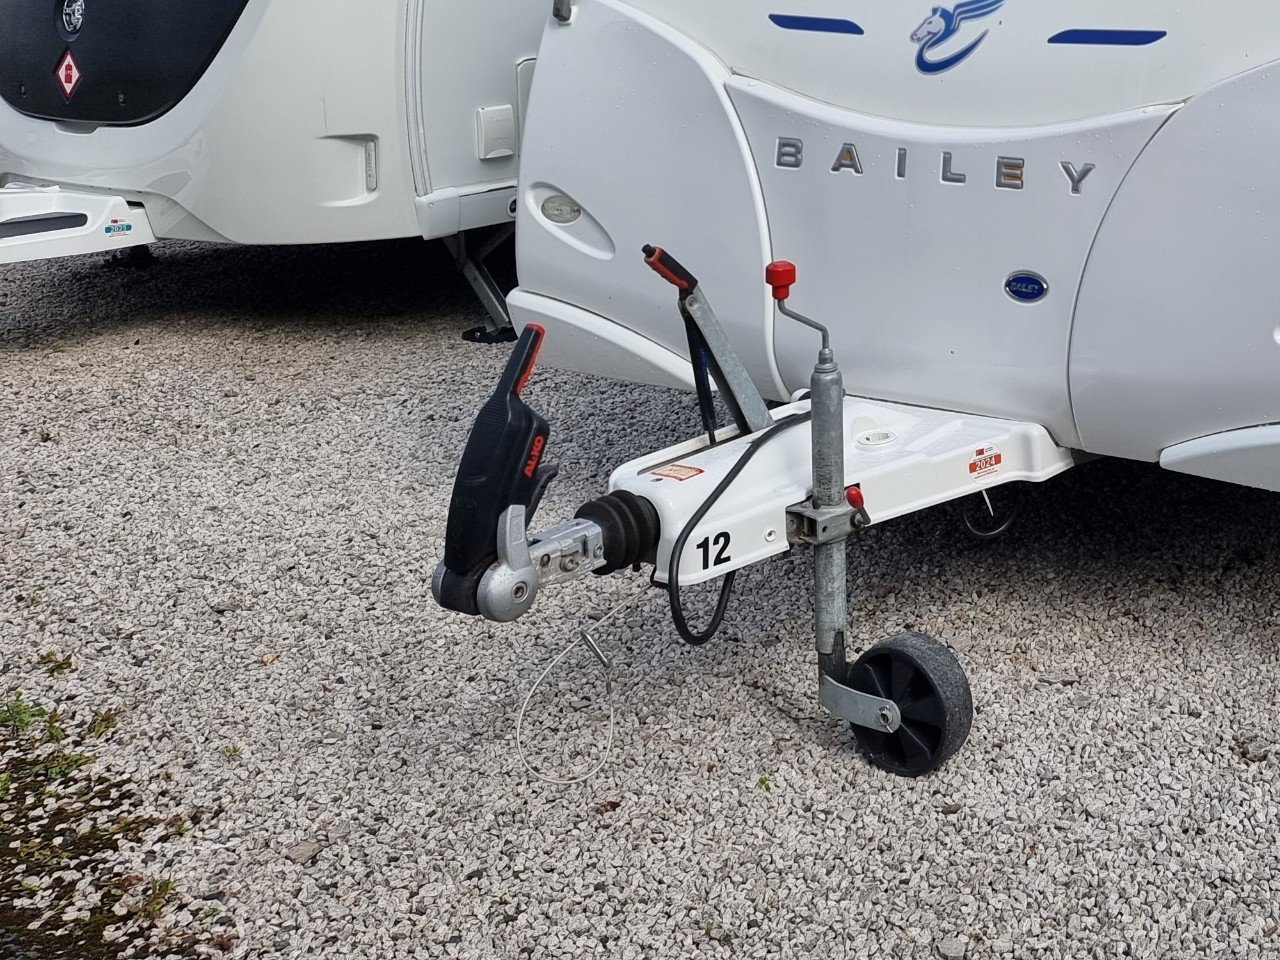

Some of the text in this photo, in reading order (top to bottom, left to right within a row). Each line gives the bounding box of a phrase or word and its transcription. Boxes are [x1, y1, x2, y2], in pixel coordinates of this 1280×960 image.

[775, 136, 1096, 195] BAILEY
[976, 456, 996, 471] 2024
[696, 531, 731, 570] 12
